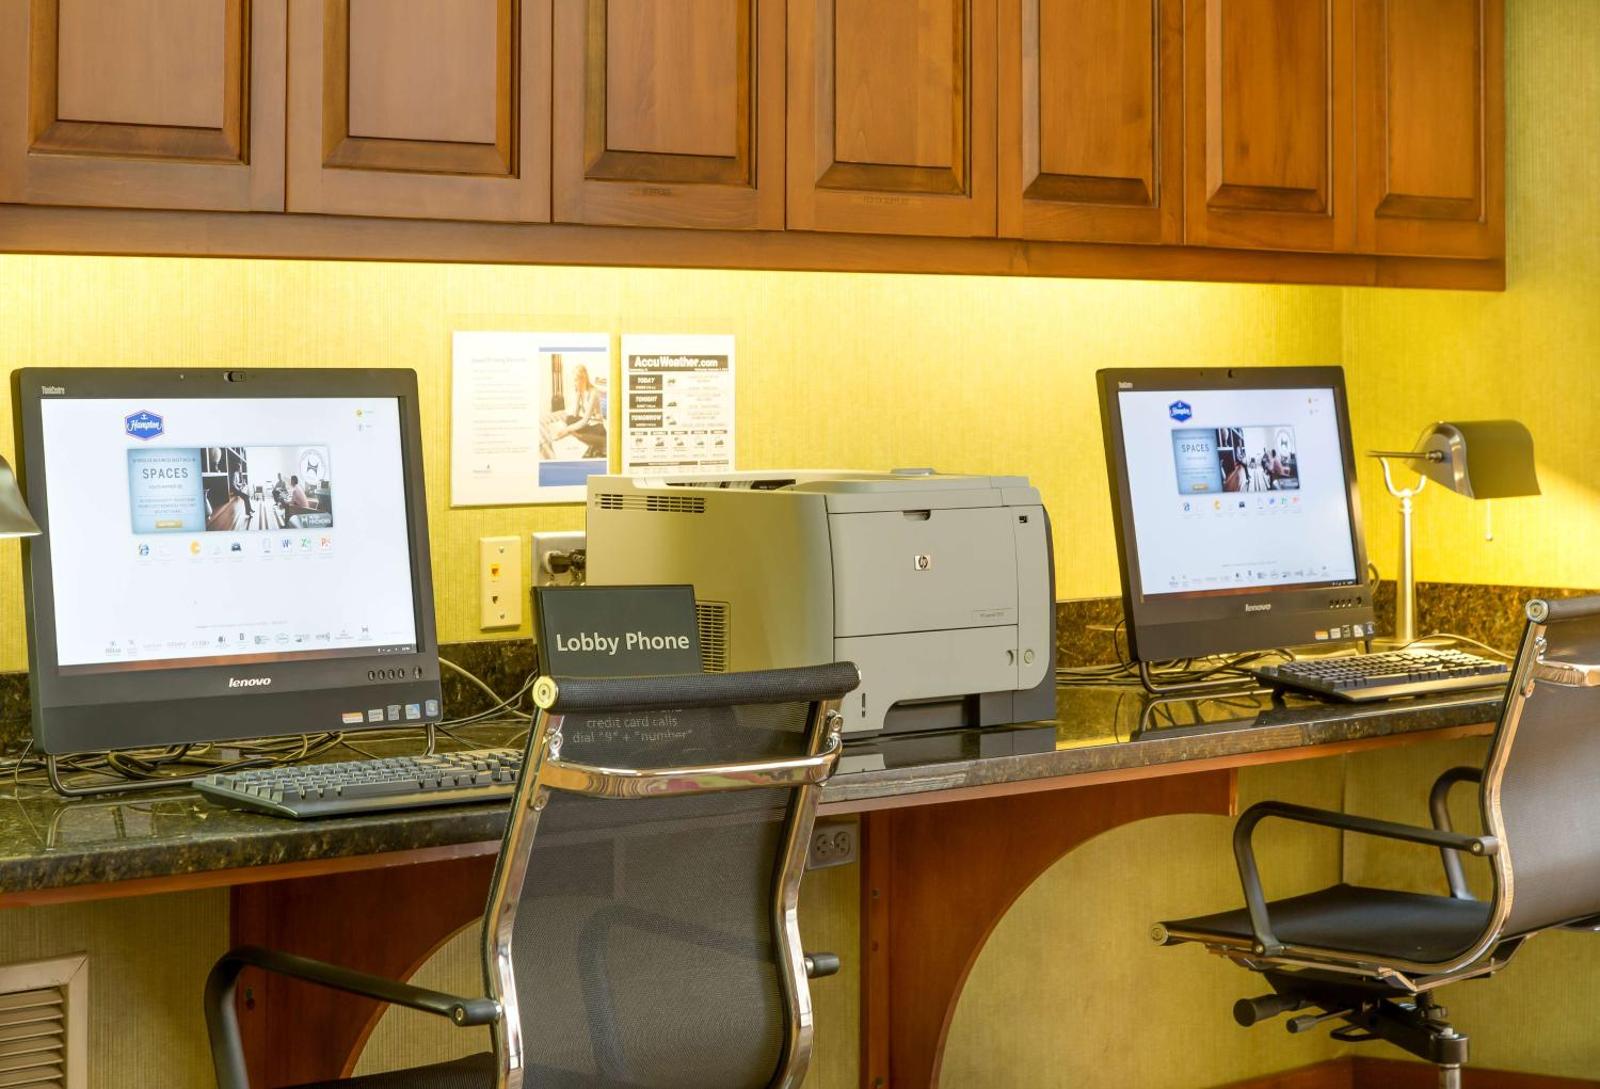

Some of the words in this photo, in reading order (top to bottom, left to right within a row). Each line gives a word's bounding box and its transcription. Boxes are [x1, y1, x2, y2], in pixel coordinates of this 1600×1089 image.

[634, 355, 718, 368] AccuWeather.com
[127, 419, 162, 432] Hampton
[1181, 443, 1210, 453] SPACES
[142, 467, 189, 479] SPACES
[1245, 603, 1271, 612] lenovo
[556, 632, 619, 655] Lobby
[626, 632, 690, 650] Phone
[228, 677, 272, 688] lenovo
[586, 717, 621, 729] credit
[623, 717, 649, 728] card
[573, 732, 595, 743] dial
